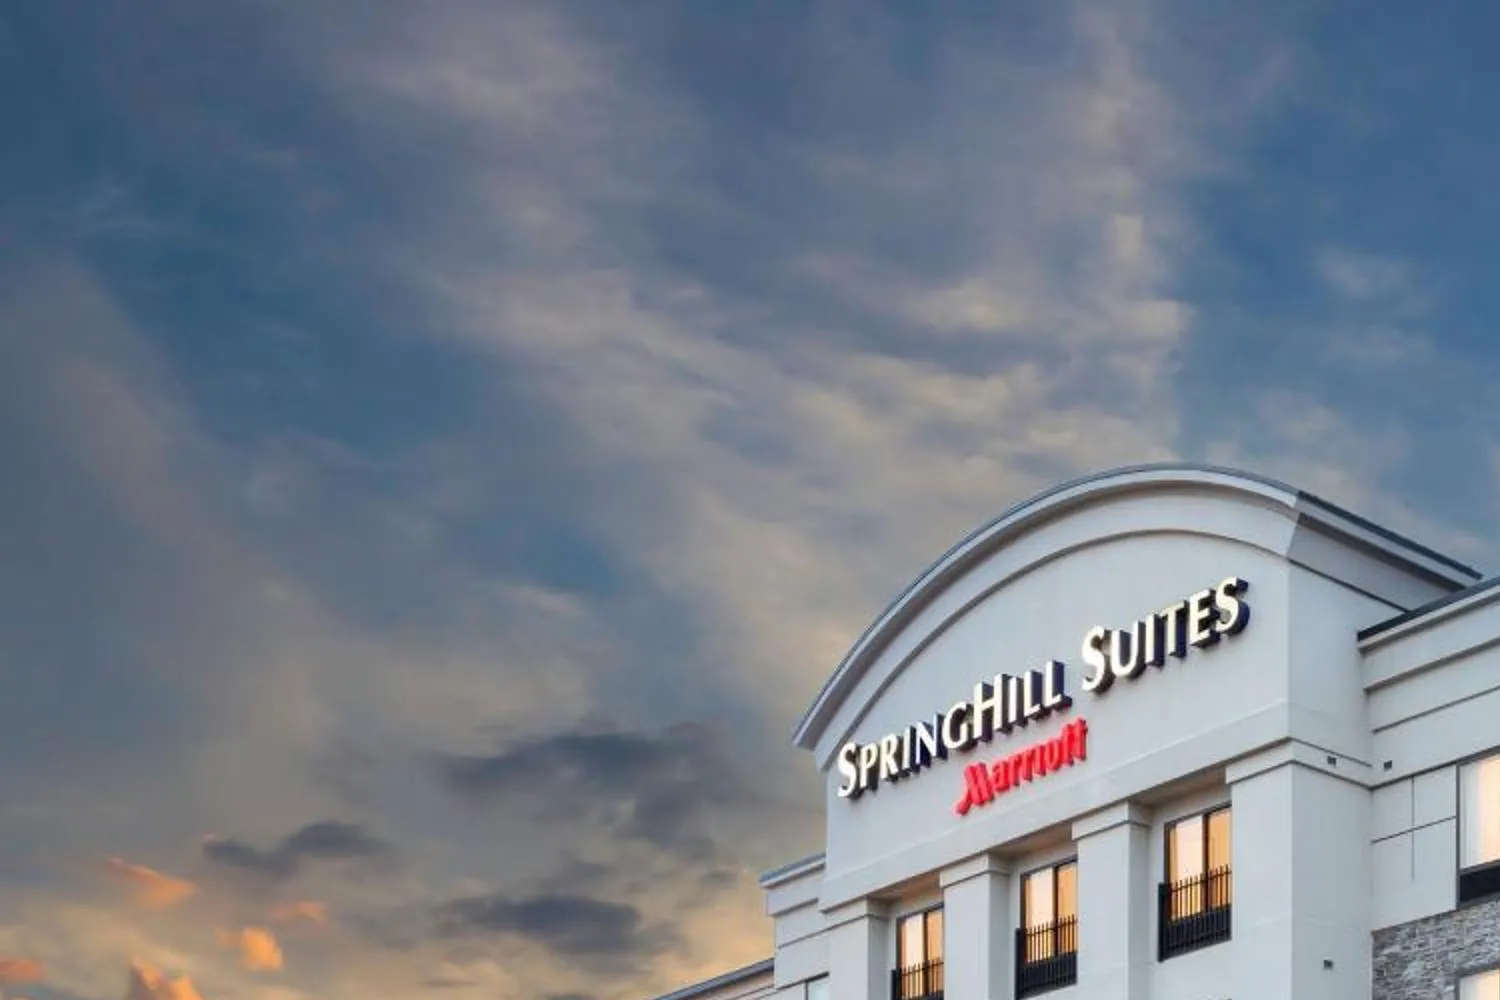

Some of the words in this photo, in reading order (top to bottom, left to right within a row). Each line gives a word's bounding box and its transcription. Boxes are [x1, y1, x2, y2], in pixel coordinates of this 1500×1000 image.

[837, 659, 1072, 799] SPRINGHILL
[1081, 576, 1250, 694] SUITES
[954, 717, 1089, 816] Marriott
